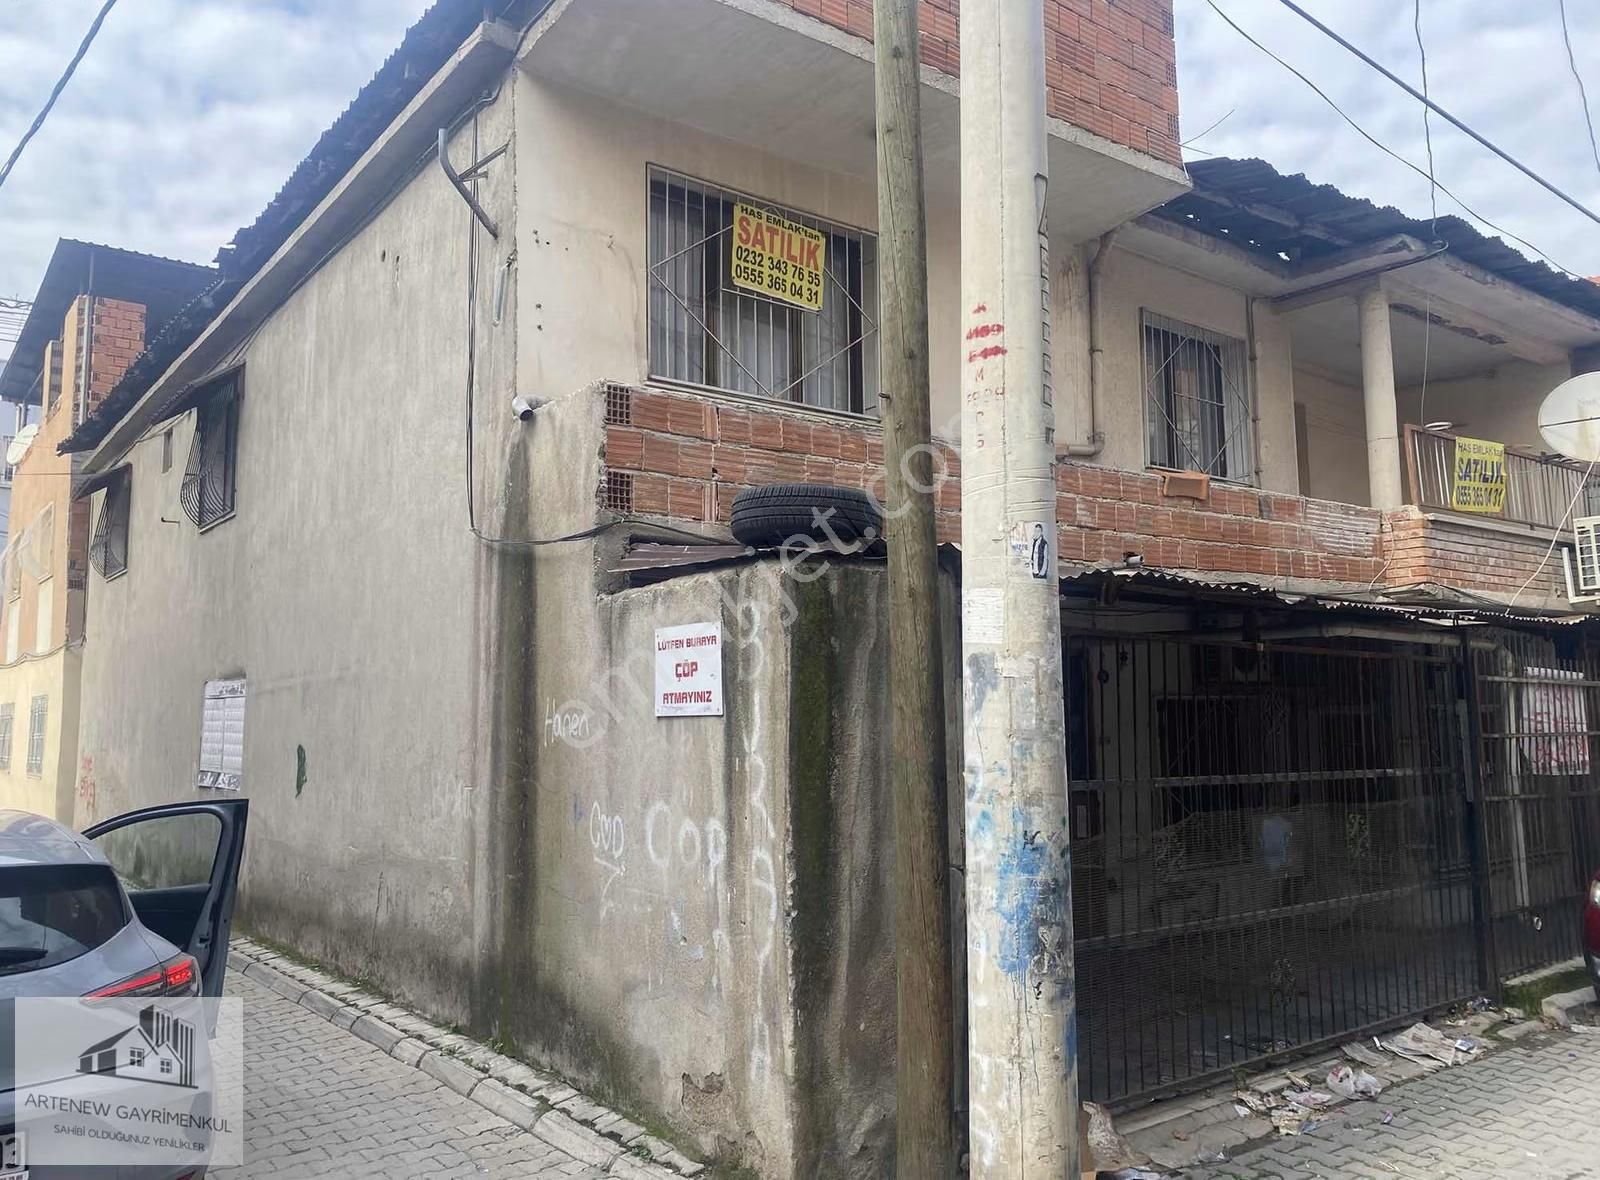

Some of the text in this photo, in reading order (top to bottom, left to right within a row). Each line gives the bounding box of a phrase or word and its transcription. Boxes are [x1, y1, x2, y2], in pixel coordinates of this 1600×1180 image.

[740, 205, 820, 241] HAS EMLAK'tan
[738, 215, 820, 272] SATILIK
[736, 245, 820, 287] 0232 343 76 55
[735, 265, 819, 304] 0555 365 04 31
[1458, 442, 1472, 454] HAS
[1458, 457, 1504, 484] SATILIK
[1493, 488, 1503, 507] 31
[686, 635, 717, 648] BURAYA
[675, 659, 698, 682] ÇÖP
[663, 690, 712, 704] ATMAYINIZ
